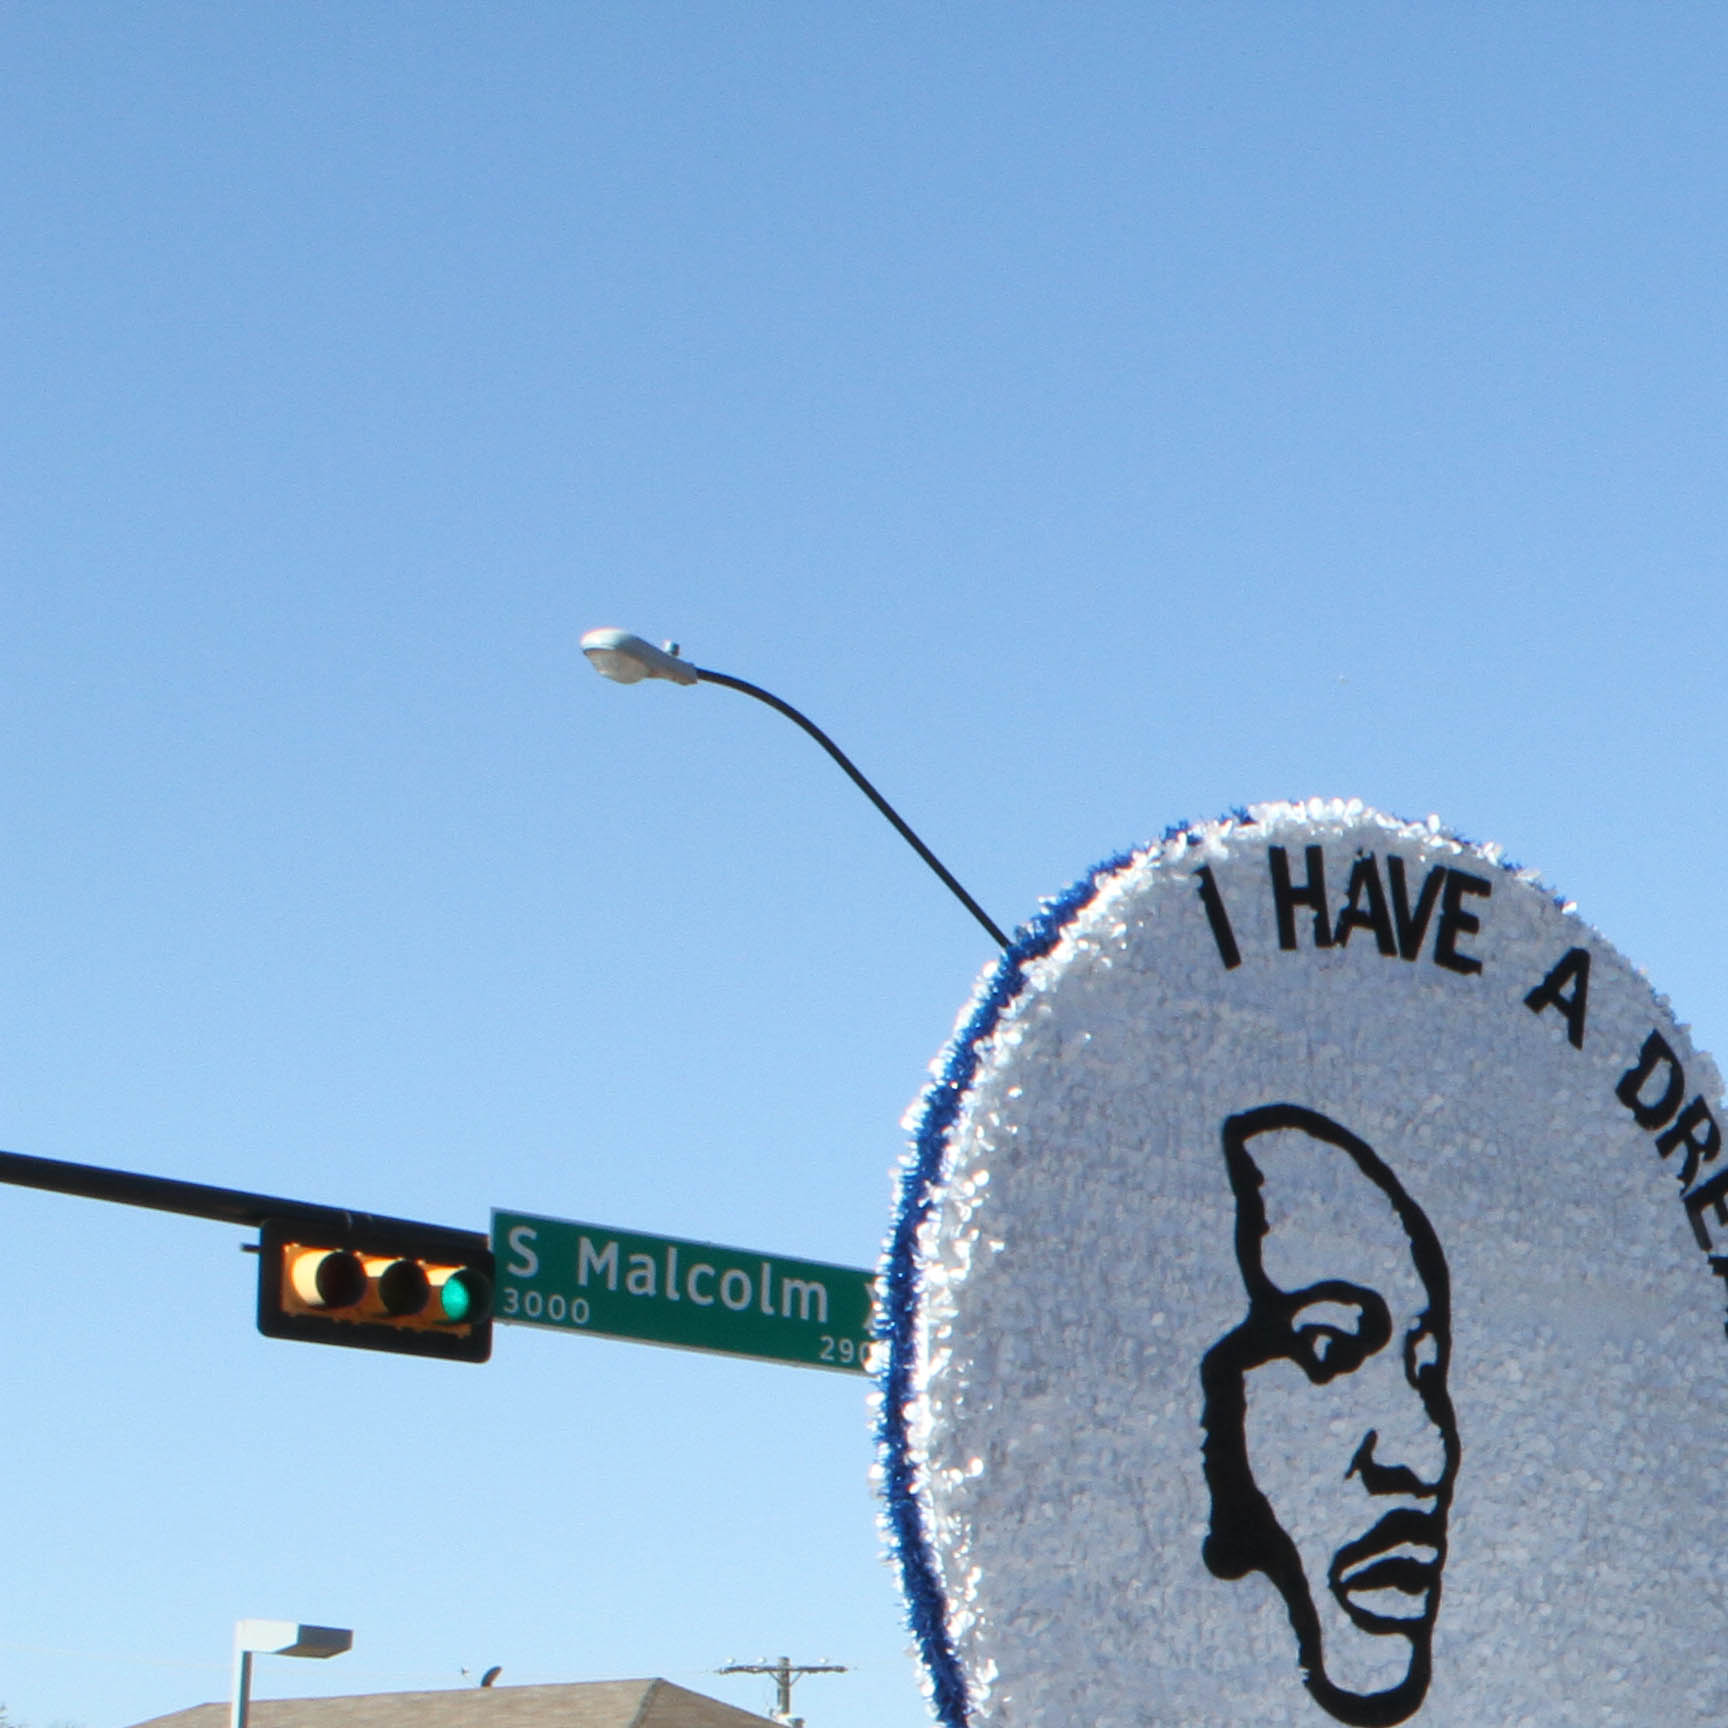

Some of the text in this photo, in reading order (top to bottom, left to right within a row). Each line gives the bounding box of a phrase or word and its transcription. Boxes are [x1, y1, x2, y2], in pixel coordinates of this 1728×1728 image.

[1196, 863, 1242, 970] I
[1268, 843, 1493, 976] HAVE
[1524, 946, 1592, 1050] A
[503, 1286, 591, 1326] 3000
[507, 1225, 540, 1279] S
[576, 1236, 829, 1325] Malcolm
